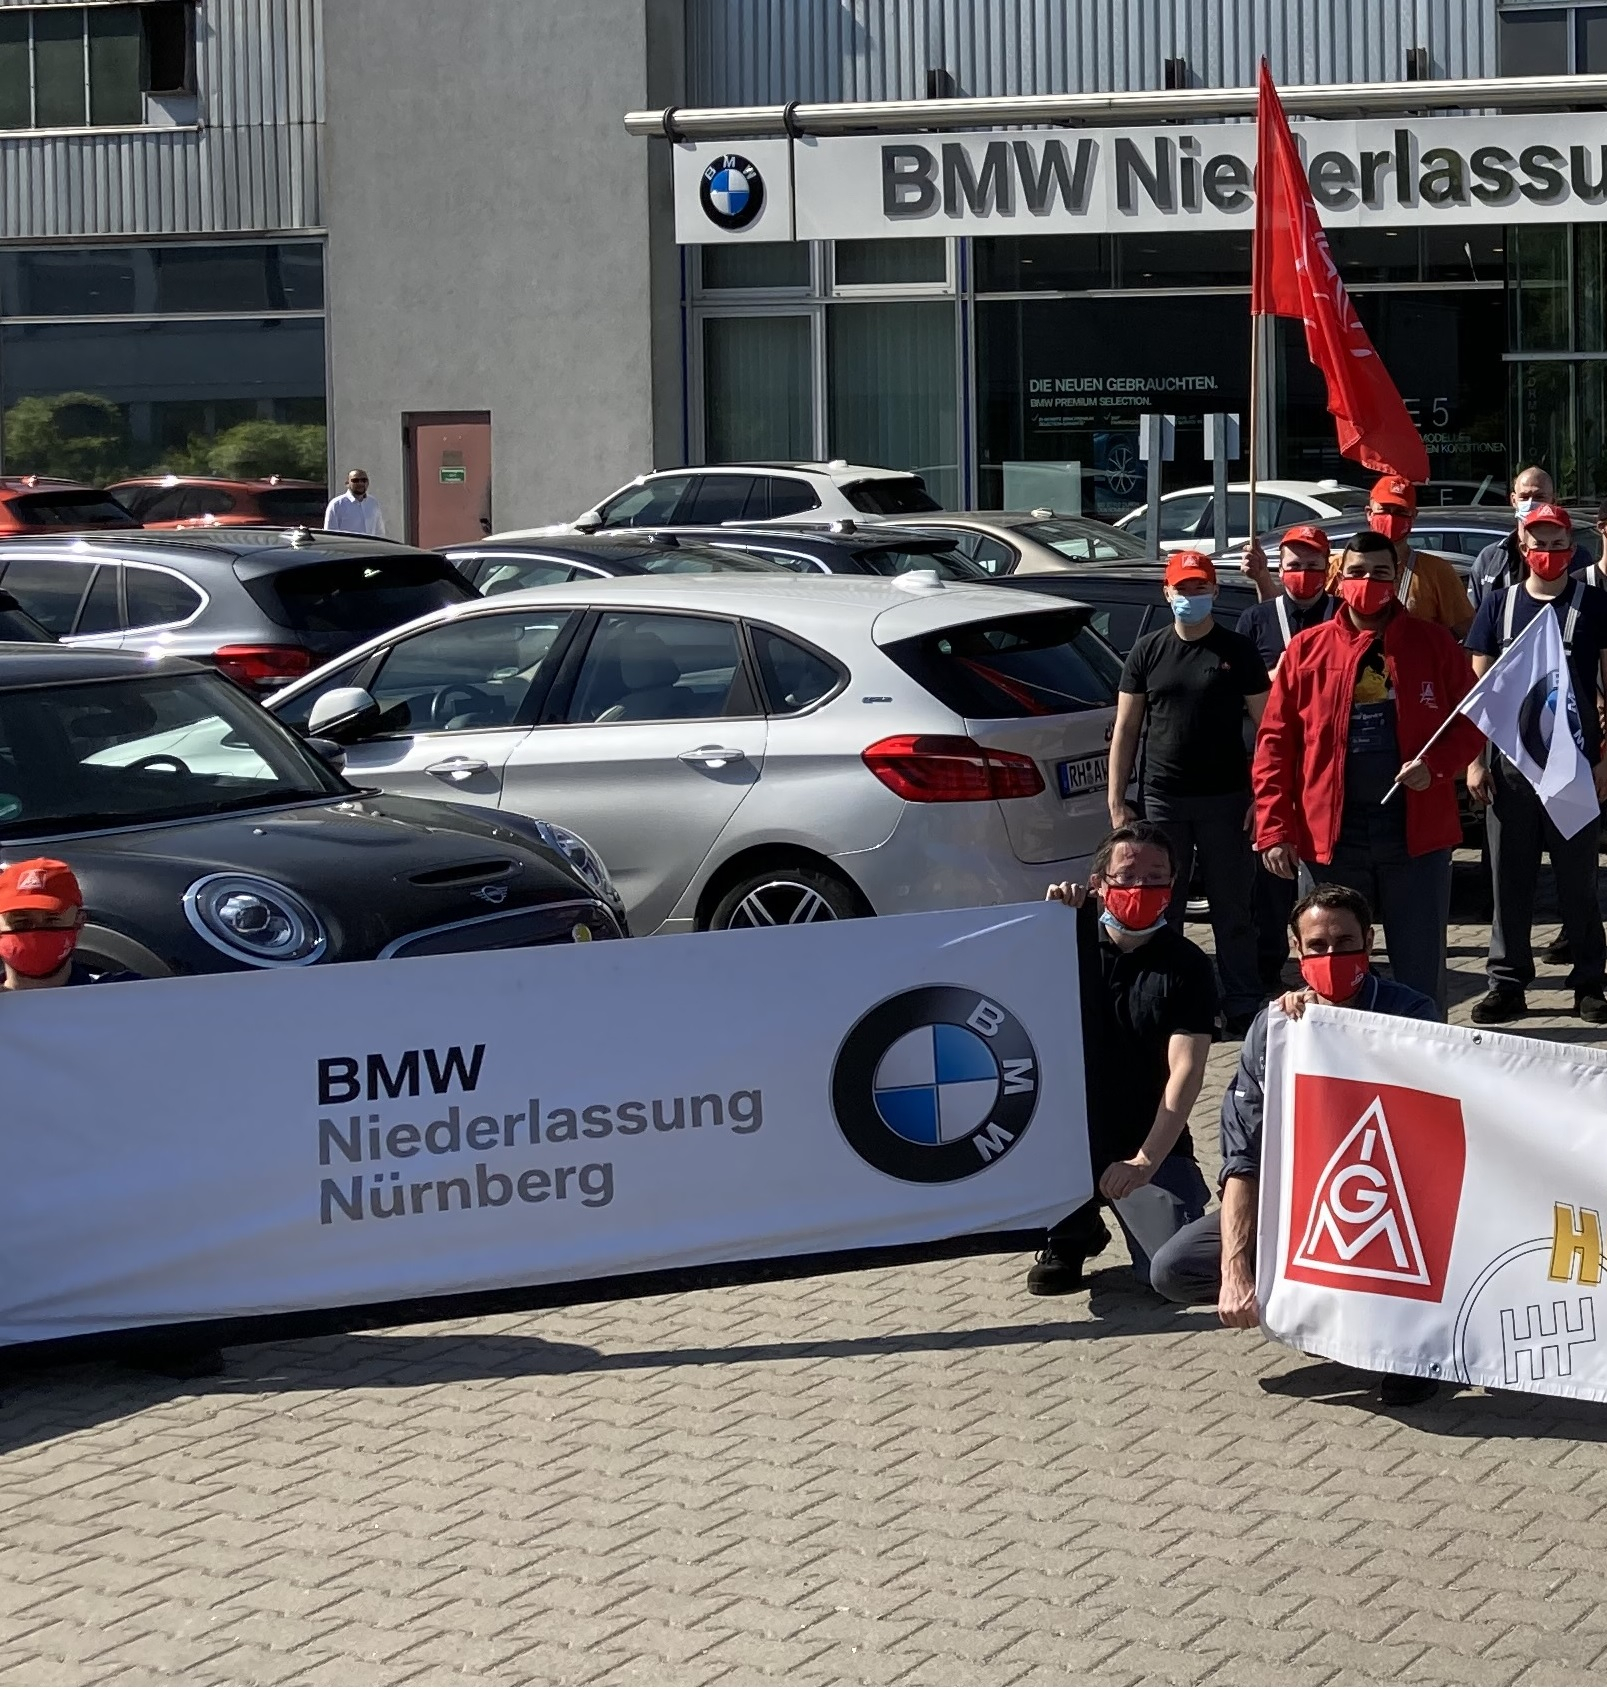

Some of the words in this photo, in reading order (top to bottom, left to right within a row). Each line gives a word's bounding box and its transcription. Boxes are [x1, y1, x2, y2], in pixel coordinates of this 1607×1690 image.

[705, 154, 757, 181] BMW
[881, 138, 1098, 220] BMW
[1029, 378, 1052, 393] DIE
[1055, 377, 1103, 392] NEUEN
[1106, 375, 1219, 391] GEBRAUCHTEN.
[1030, 398, 1054, 408] BMW
[1055, 397, 1098, 407] PREMIUM
[1099, 396, 1152, 406] SELECTION.
[1432, 397, 1449, 428] 5
[1069, 762, 1087, 788] RH
[317, 1043, 486, 1105] BMW
[966, 999, 1034, 1163] BMW
[318, 1088, 764, 1166] Niederlassung
[319, 1160, 615, 1225] Nürnberg
